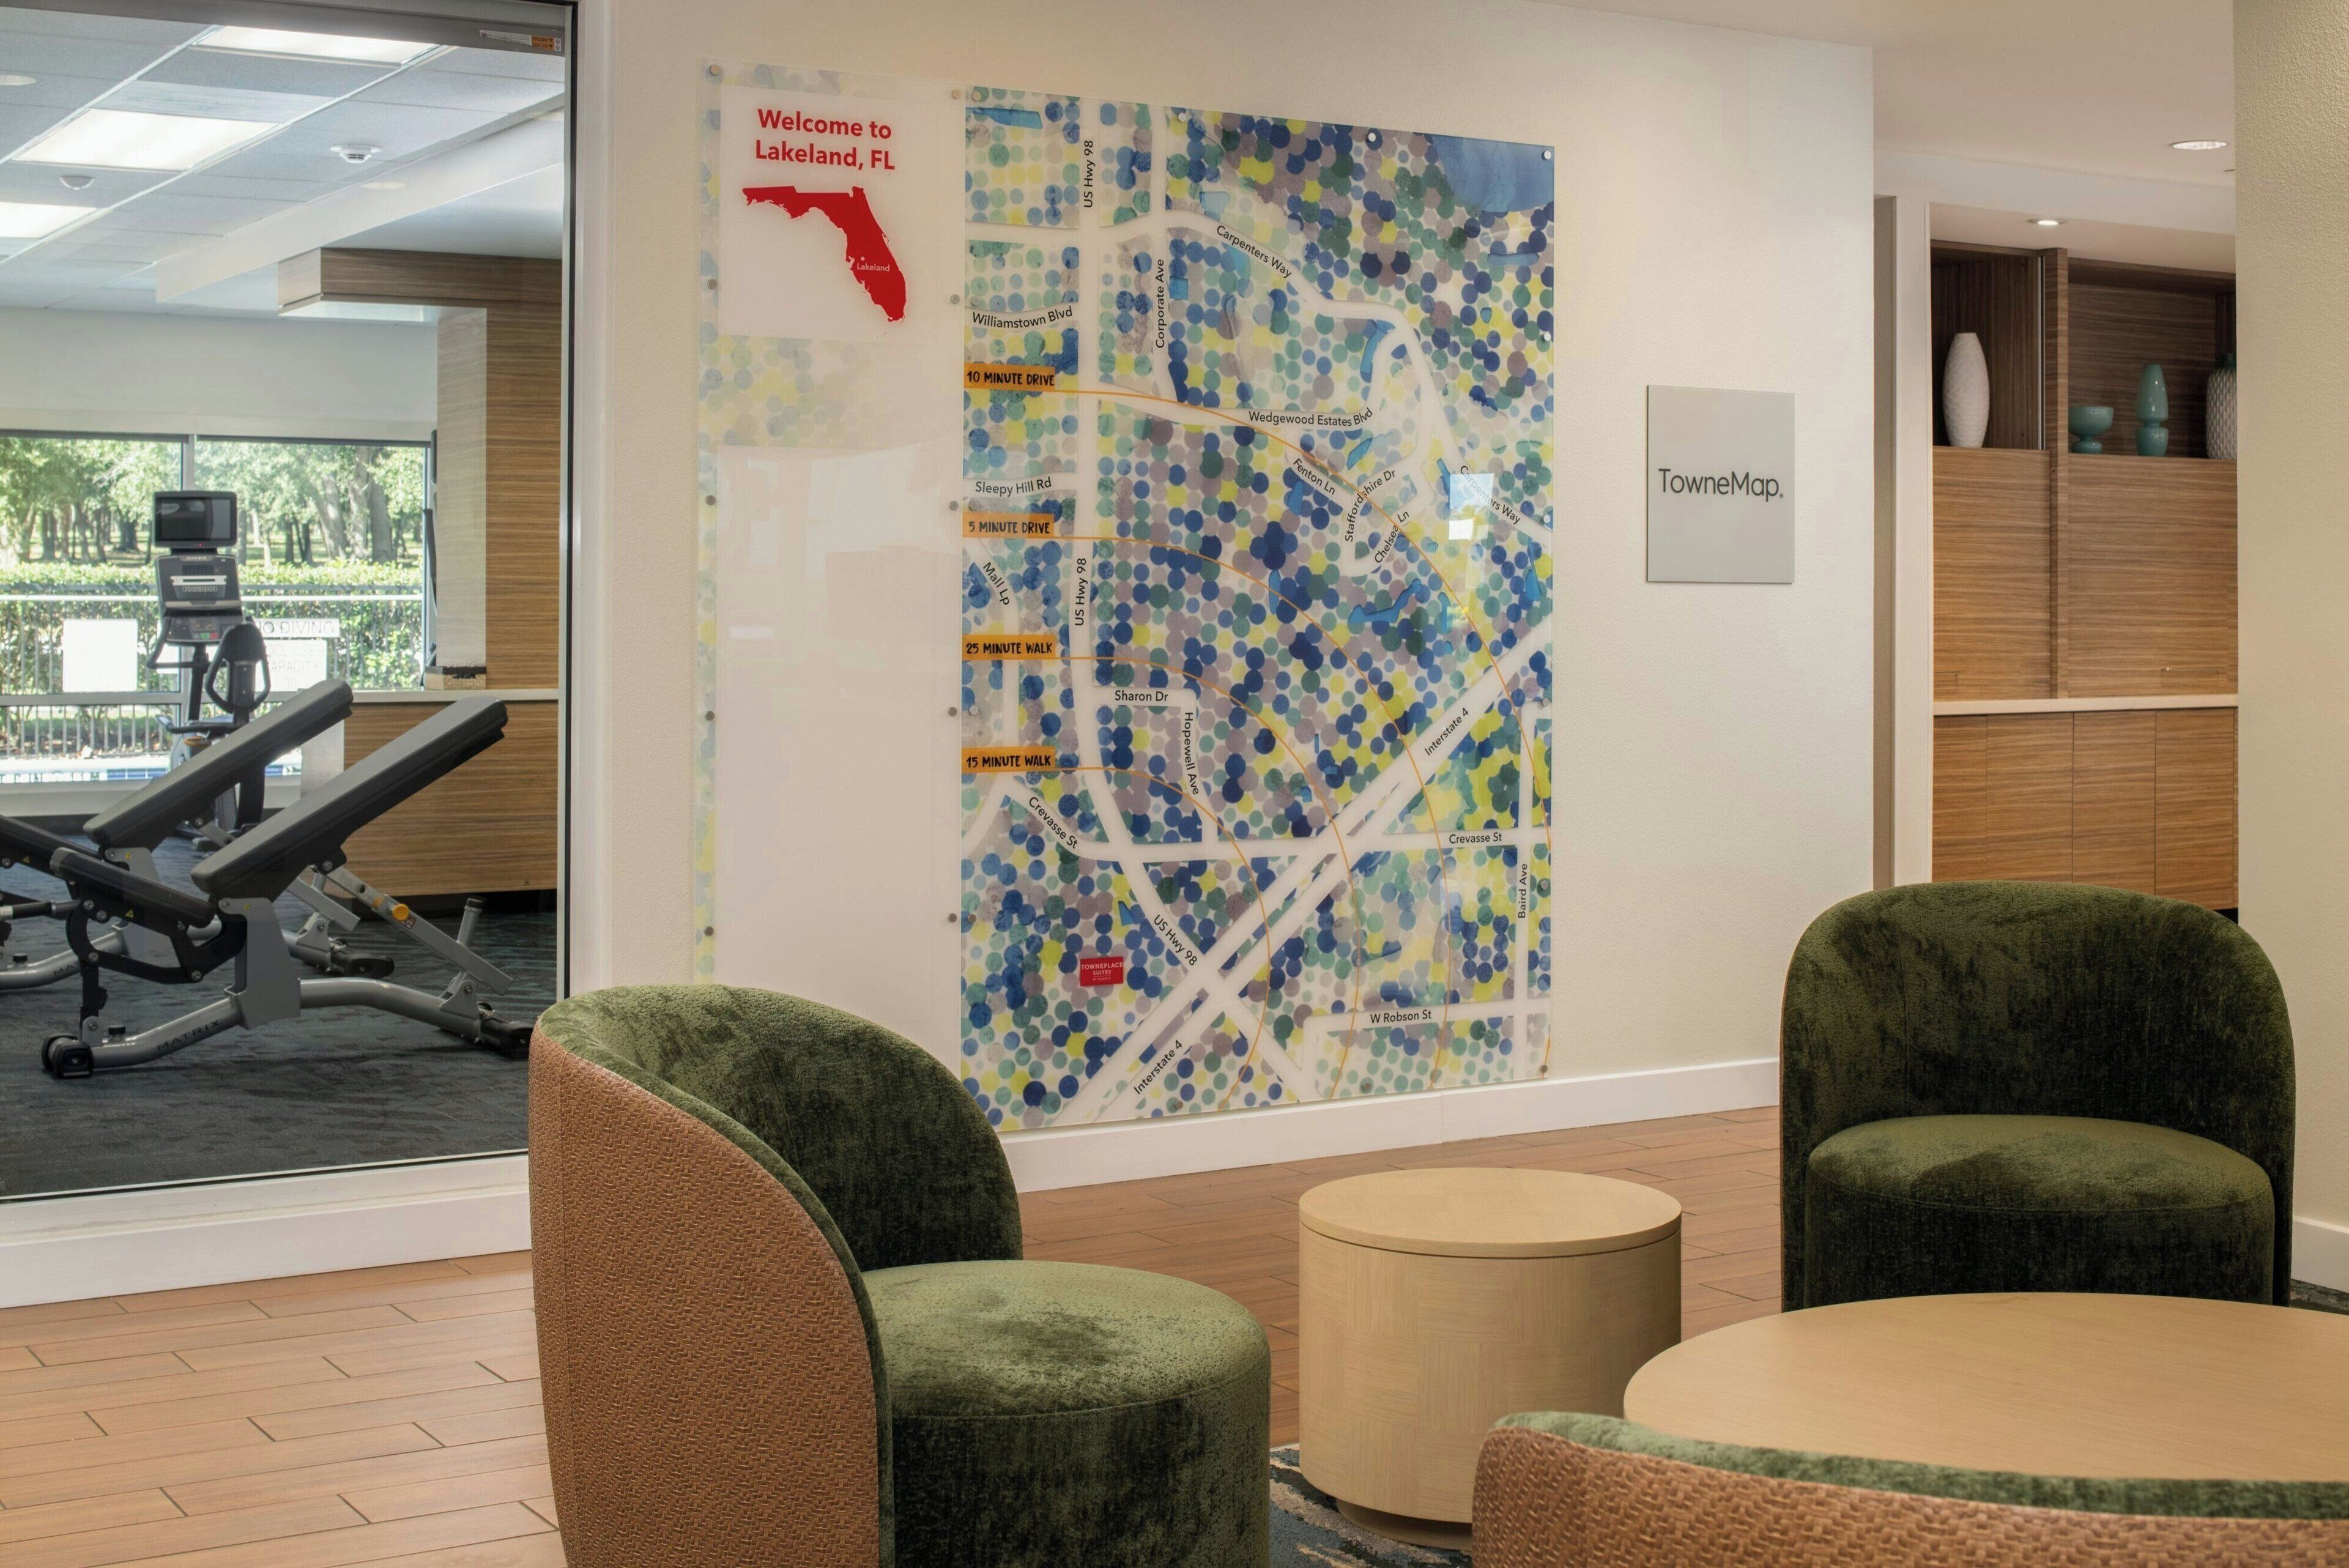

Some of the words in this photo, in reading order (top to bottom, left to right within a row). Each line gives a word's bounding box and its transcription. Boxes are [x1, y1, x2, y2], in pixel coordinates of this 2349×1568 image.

[758, 108, 863, 137] Welcome
[869, 121, 892, 139] to
[755, 140, 864, 170] Lakeland,
[870, 150, 895, 170] FL
[1083, 139, 1093, 155] 98
[1083, 158, 1096, 187] Hwy
[1083, 191, 1093, 208] US
[1216, 225, 1269, 263] Carpenters
[1271, 255, 1292, 278] Way
[857, 263, 890, 272] Lakeland
[1156, 259, 1164, 281] Ave
[973, 311, 1046, 329] Williamstown
[1047, 307, 1072, 322] Blvd
[1156, 284, 1167, 348] Corporate
[967, 371, 980, 384] 10
[984, 372, 1023, 385] MINUTE
[1026, 373, 1055, 387] DRIVE
[1249, 411, 1314, 425] Wedgewood
[1318, 414, 1352, 426] Estates
[1353, 407, 1373, 426] Blvd
[975, 481, 1013, 496] Sleepy
[1016, 478, 1034, 493] Hill
[1036, 477, 1052, 490] Rd
[1293, 458, 1323, 486] Fenton
[1324, 481, 1335, 495] Ln
[1345, 478, 1382, 542] Staffordshire
[1383, 469, 1396, 481] Dr
[1502, 504, 1521, 524] Way
[969, 521, 975, 532] 5
[979, 522, 1018, 533] MINUTE
[1022, 522, 1050, 534] DRIVE
[1375, 525, 1398, 563] Chelsea
[1397, 511, 1409, 522] Ln
[1077, 558, 1086, 573] 98
[982, 562, 1002, 589] Mall
[997, 589, 1009, 606] Lp
[1075, 578, 1088, 607] Hwy
[280, 621, 334, 634] DIVING
[1075, 609, 1084, 626] US
[265, 645, 288, 657] OOL
[966, 643, 979, 654] 25
[983, 642, 1022, 655] MINUTE
[1025, 642, 1052, 654] WALK
[1115, 690, 1152, 702] Sharon
[1155, 691, 1169, 702] Dr
[1181, 712, 1195, 771] Hopewell
[1425, 715, 1463, 756] Interstate
[1461, 707, 1469, 718] 4
[967, 757, 978, 767] 15
[982, 756, 1020, 768] MINUTE
[1024, 755, 1051, 767] WALK
[1187, 773, 1199, 795] Ave
[1029, 797, 1066, 840] Crevasse
[1066, 836, 1078, 849] St
[1449, 833, 1490, 844] Crevasse
[1493, 832, 1502, 842] St
[1518, 864, 1527, 885] Ave
[1518, 888, 1527, 918] Baird
[1154, 915, 1170, 932] US
[1166, 931, 1186, 957] Hwy
[1183, 951, 1198, 966] 98
[1081, 962, 1123, 970] TOWNEPLACE
[1370, 1014, 1381, 1024] W
[1384, 1011, 1419, 1024] Robson
[1422, 1010, 1432, 1020] St
[157, 1019, 221, 1051] MATRIX
[1134, 1049, 1175, 1095] Interstate
[1173, 1039, 1183, 1050] 4
